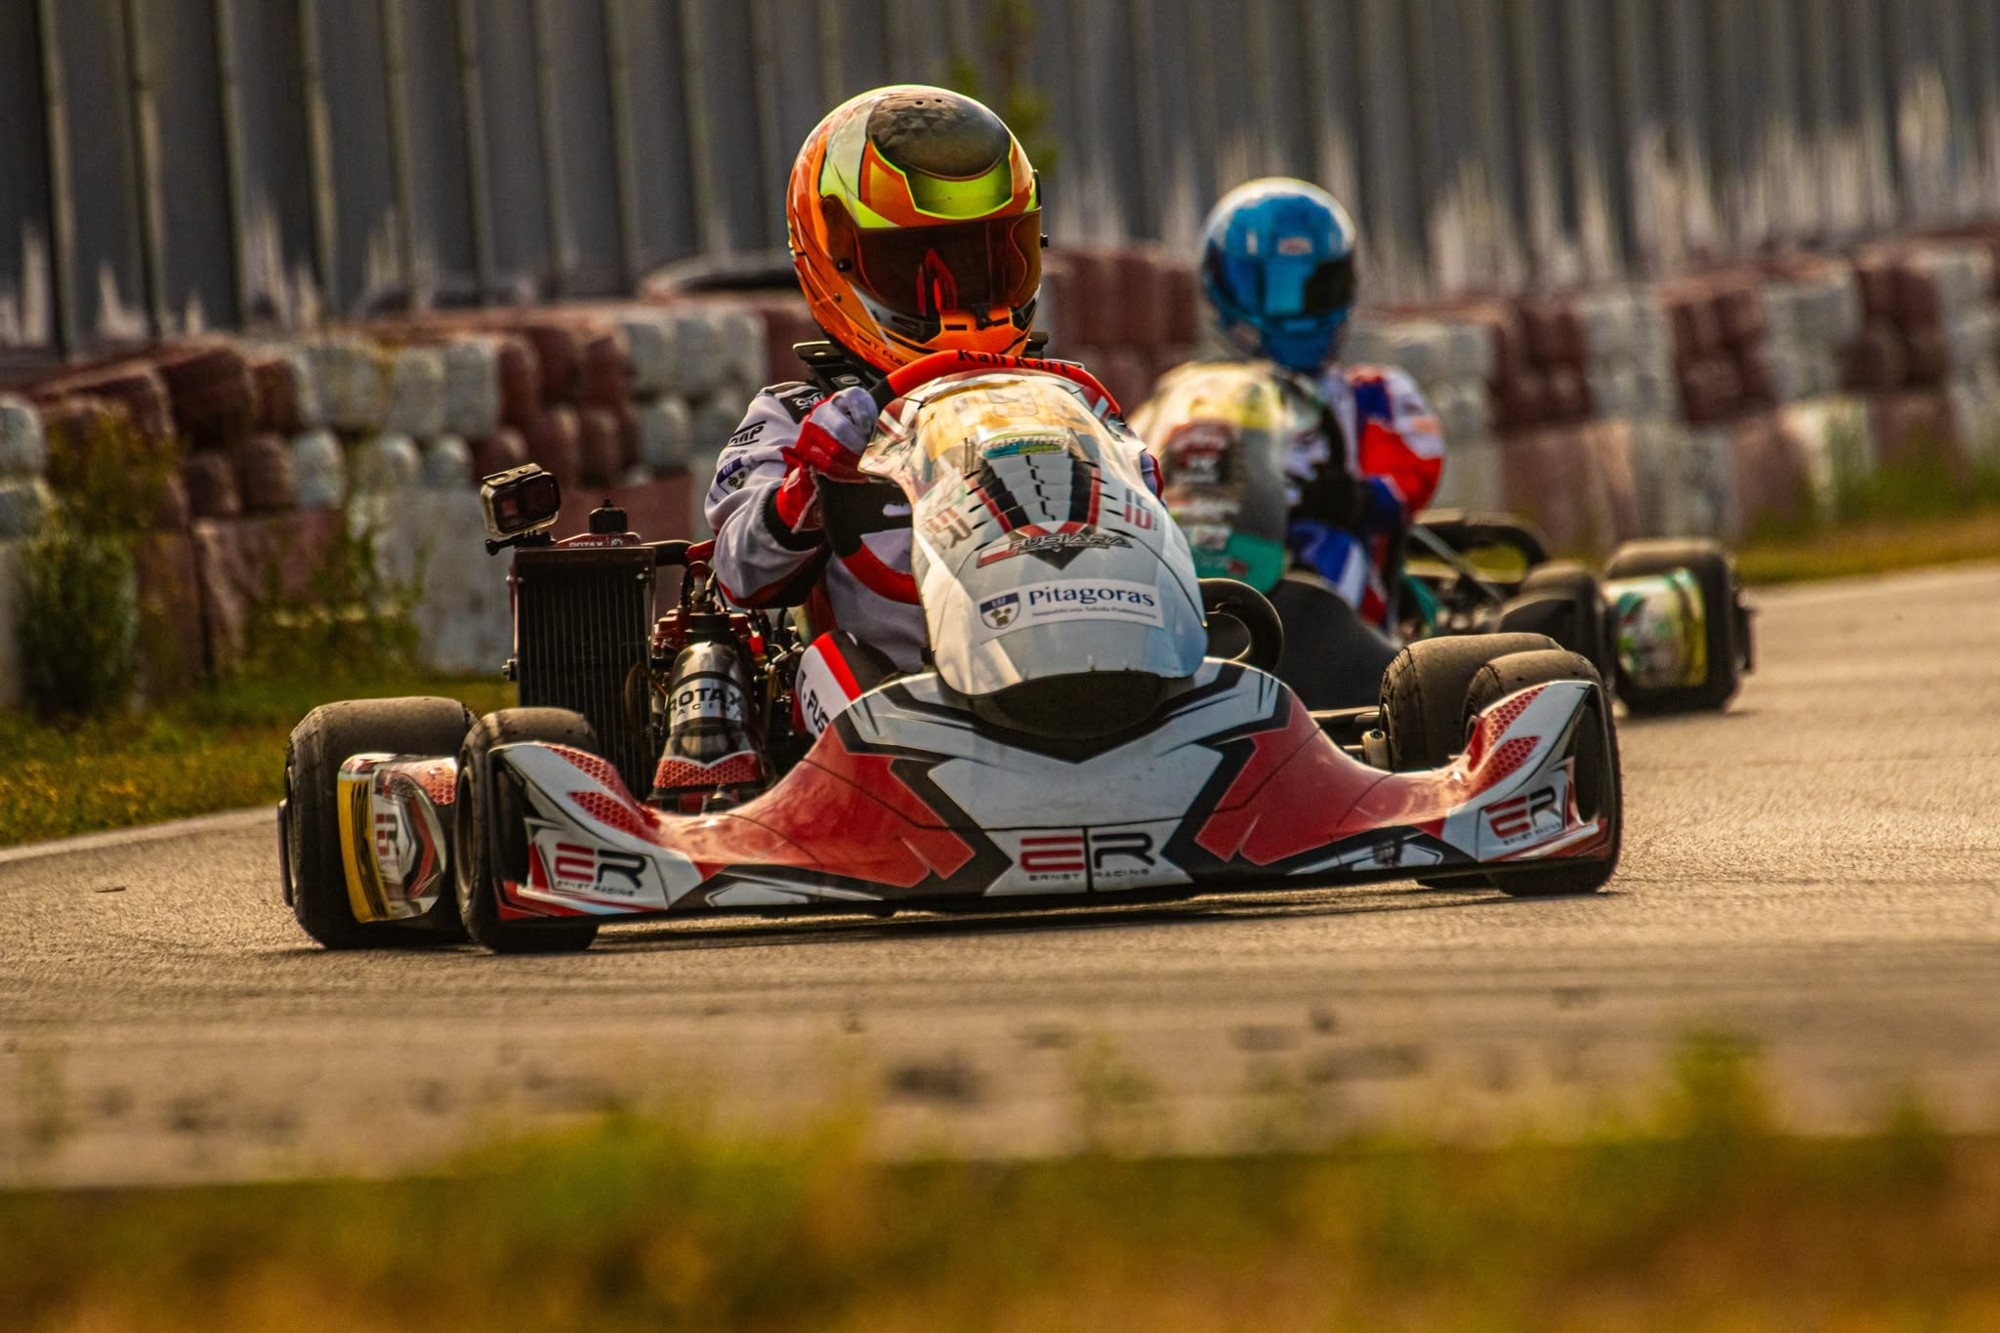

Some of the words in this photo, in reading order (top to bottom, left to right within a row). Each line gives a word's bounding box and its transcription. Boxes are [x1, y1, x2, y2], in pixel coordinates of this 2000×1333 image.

[1009, 533, 1134, 553] FUSIARA
[1028, 586, 1156, 608] Pitagoras
[1020, 832, 1156, 873] ER
[554, 842, 648, 891] ER
[1029, 873, 1081, 882] ERNST
[1093, 868, 1150, 879] RACING
